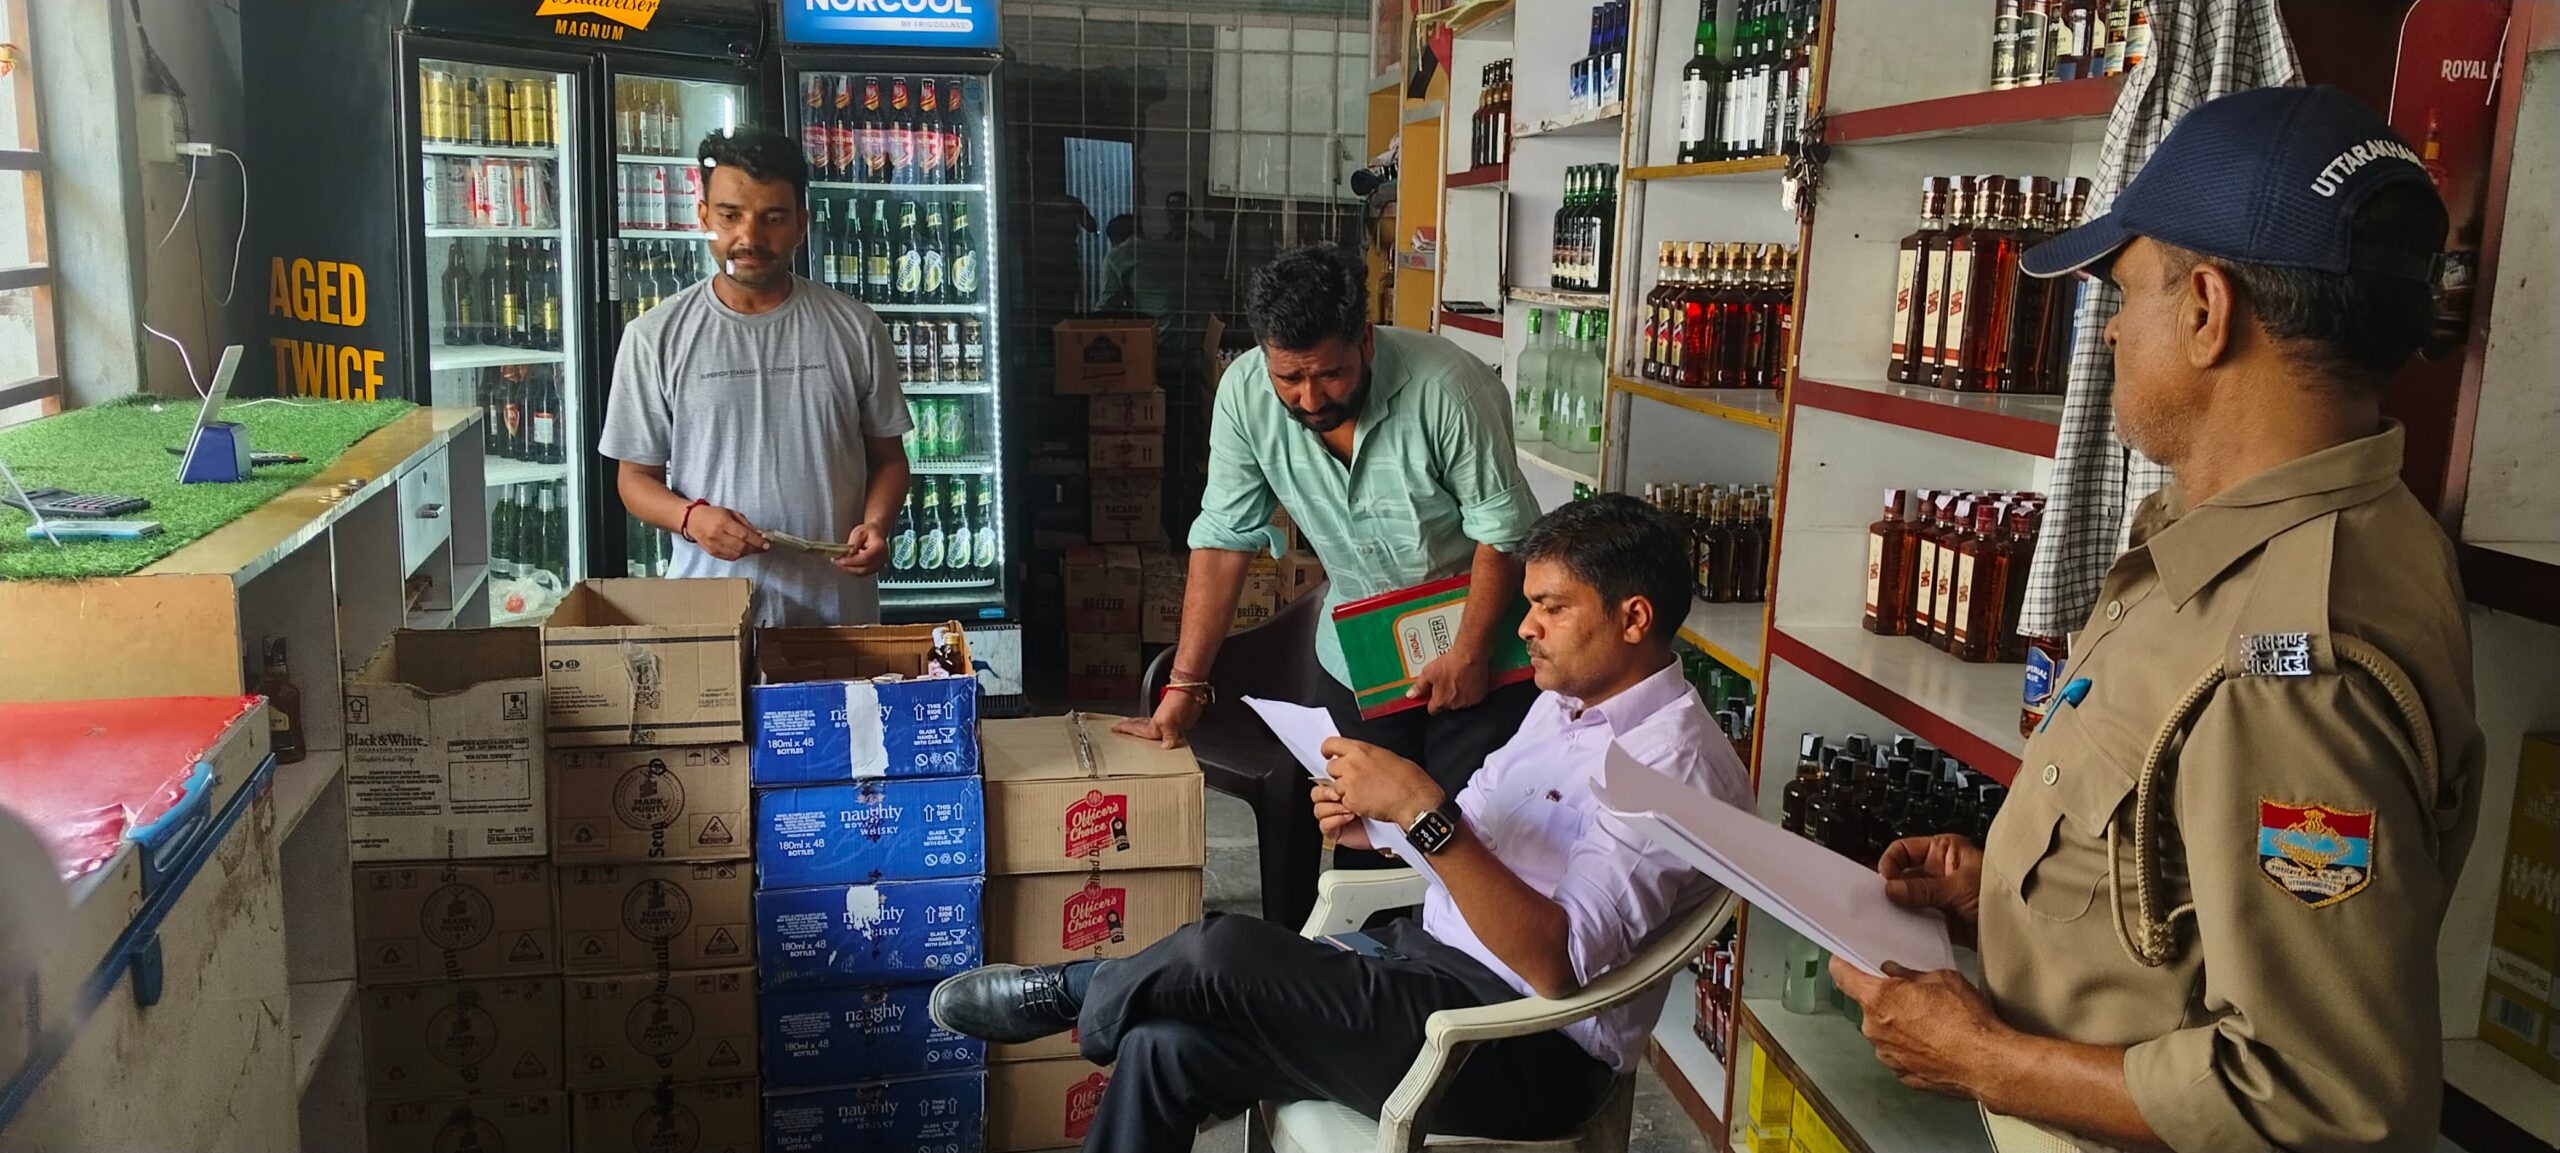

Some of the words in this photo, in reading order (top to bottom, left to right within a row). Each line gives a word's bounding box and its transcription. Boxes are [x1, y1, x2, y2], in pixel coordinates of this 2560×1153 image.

[555, 19, 624, 40] MAGNUM
[2441, 60, 2487, 81] ROYAL
[269, 257, 366, 327] AGED
[1083, 598, 1124, 611] BREEZER
[1160, 606, 1182, 614] BACA
[1238, 608, 1269, 618] BREEZER
[1431, 618, 1450, 656] EGISTER
[768, 738, 792, 749] 180ml
[802, 738, 815, 747] 48
[632, 804, 668, 814] PURITY
[861, 826, 899, 836] WHISKY
[1070, 820, 1107, 842] Choice
[779, 839, 804, 850] 180ml
[813, 838, 825, 848] 48
[788, 849, 815, 857] BOTTLES
[1068, 911, 1104, 933] Choice
[781, 940, 806, 951] 180ml
[815, 939, 826, 949] 48
[818, 1039, 829, 1048] 48
[810, 1134, 822, 1143] 48
